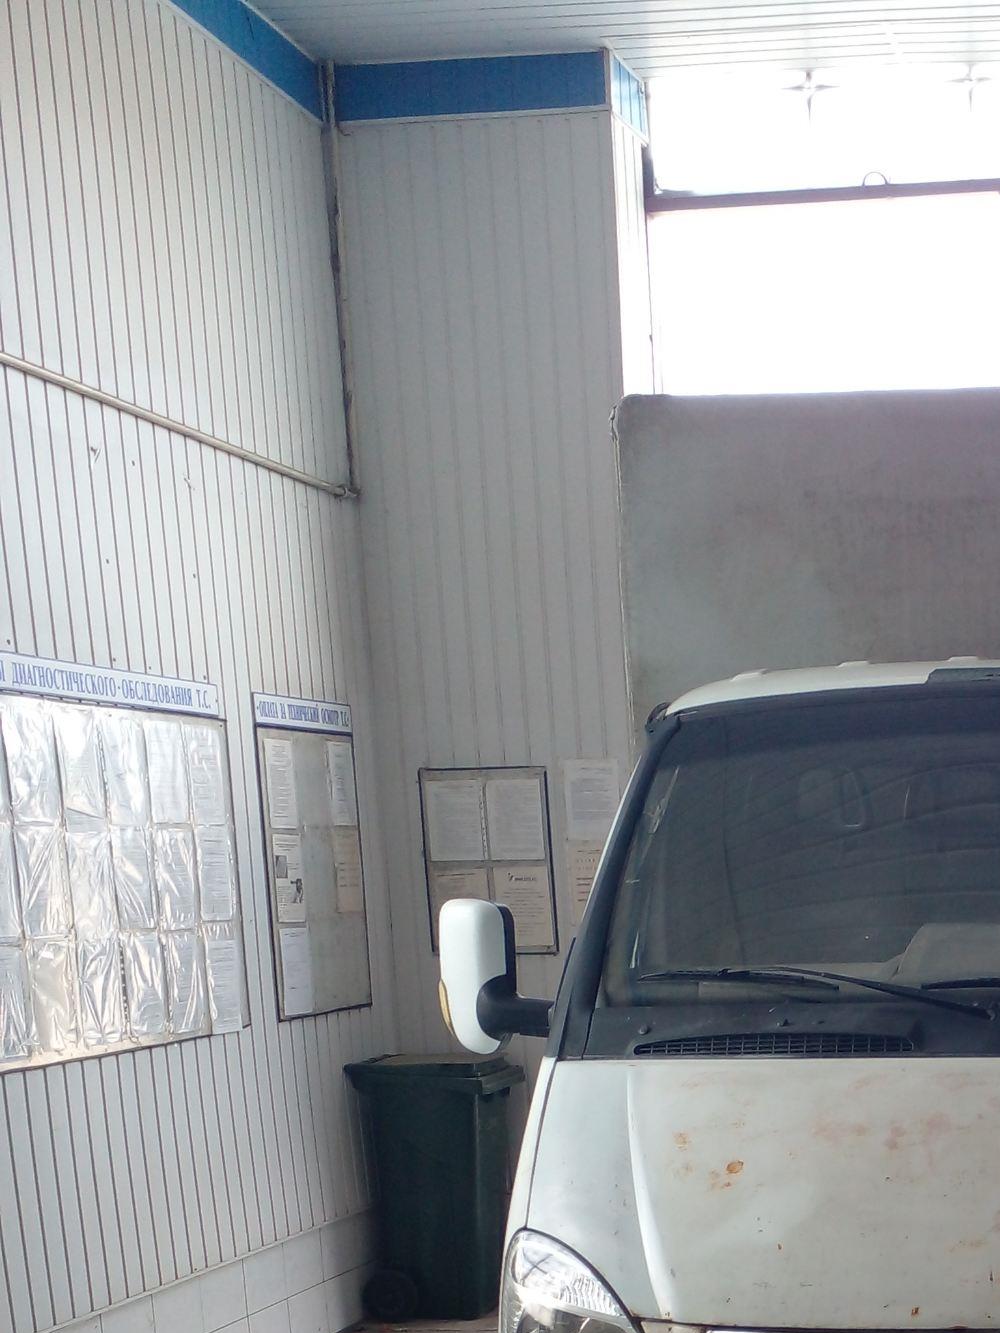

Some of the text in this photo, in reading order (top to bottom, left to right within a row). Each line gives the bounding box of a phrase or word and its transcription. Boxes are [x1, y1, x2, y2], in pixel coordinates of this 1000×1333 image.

[12, 661, 117, 698] ДИАГНОСТИЧЕСКОГО
[121, 678, 193, 707] ОБСЛЕДОВАНИЯ
[196, 689, 212, 709] Т.С.
